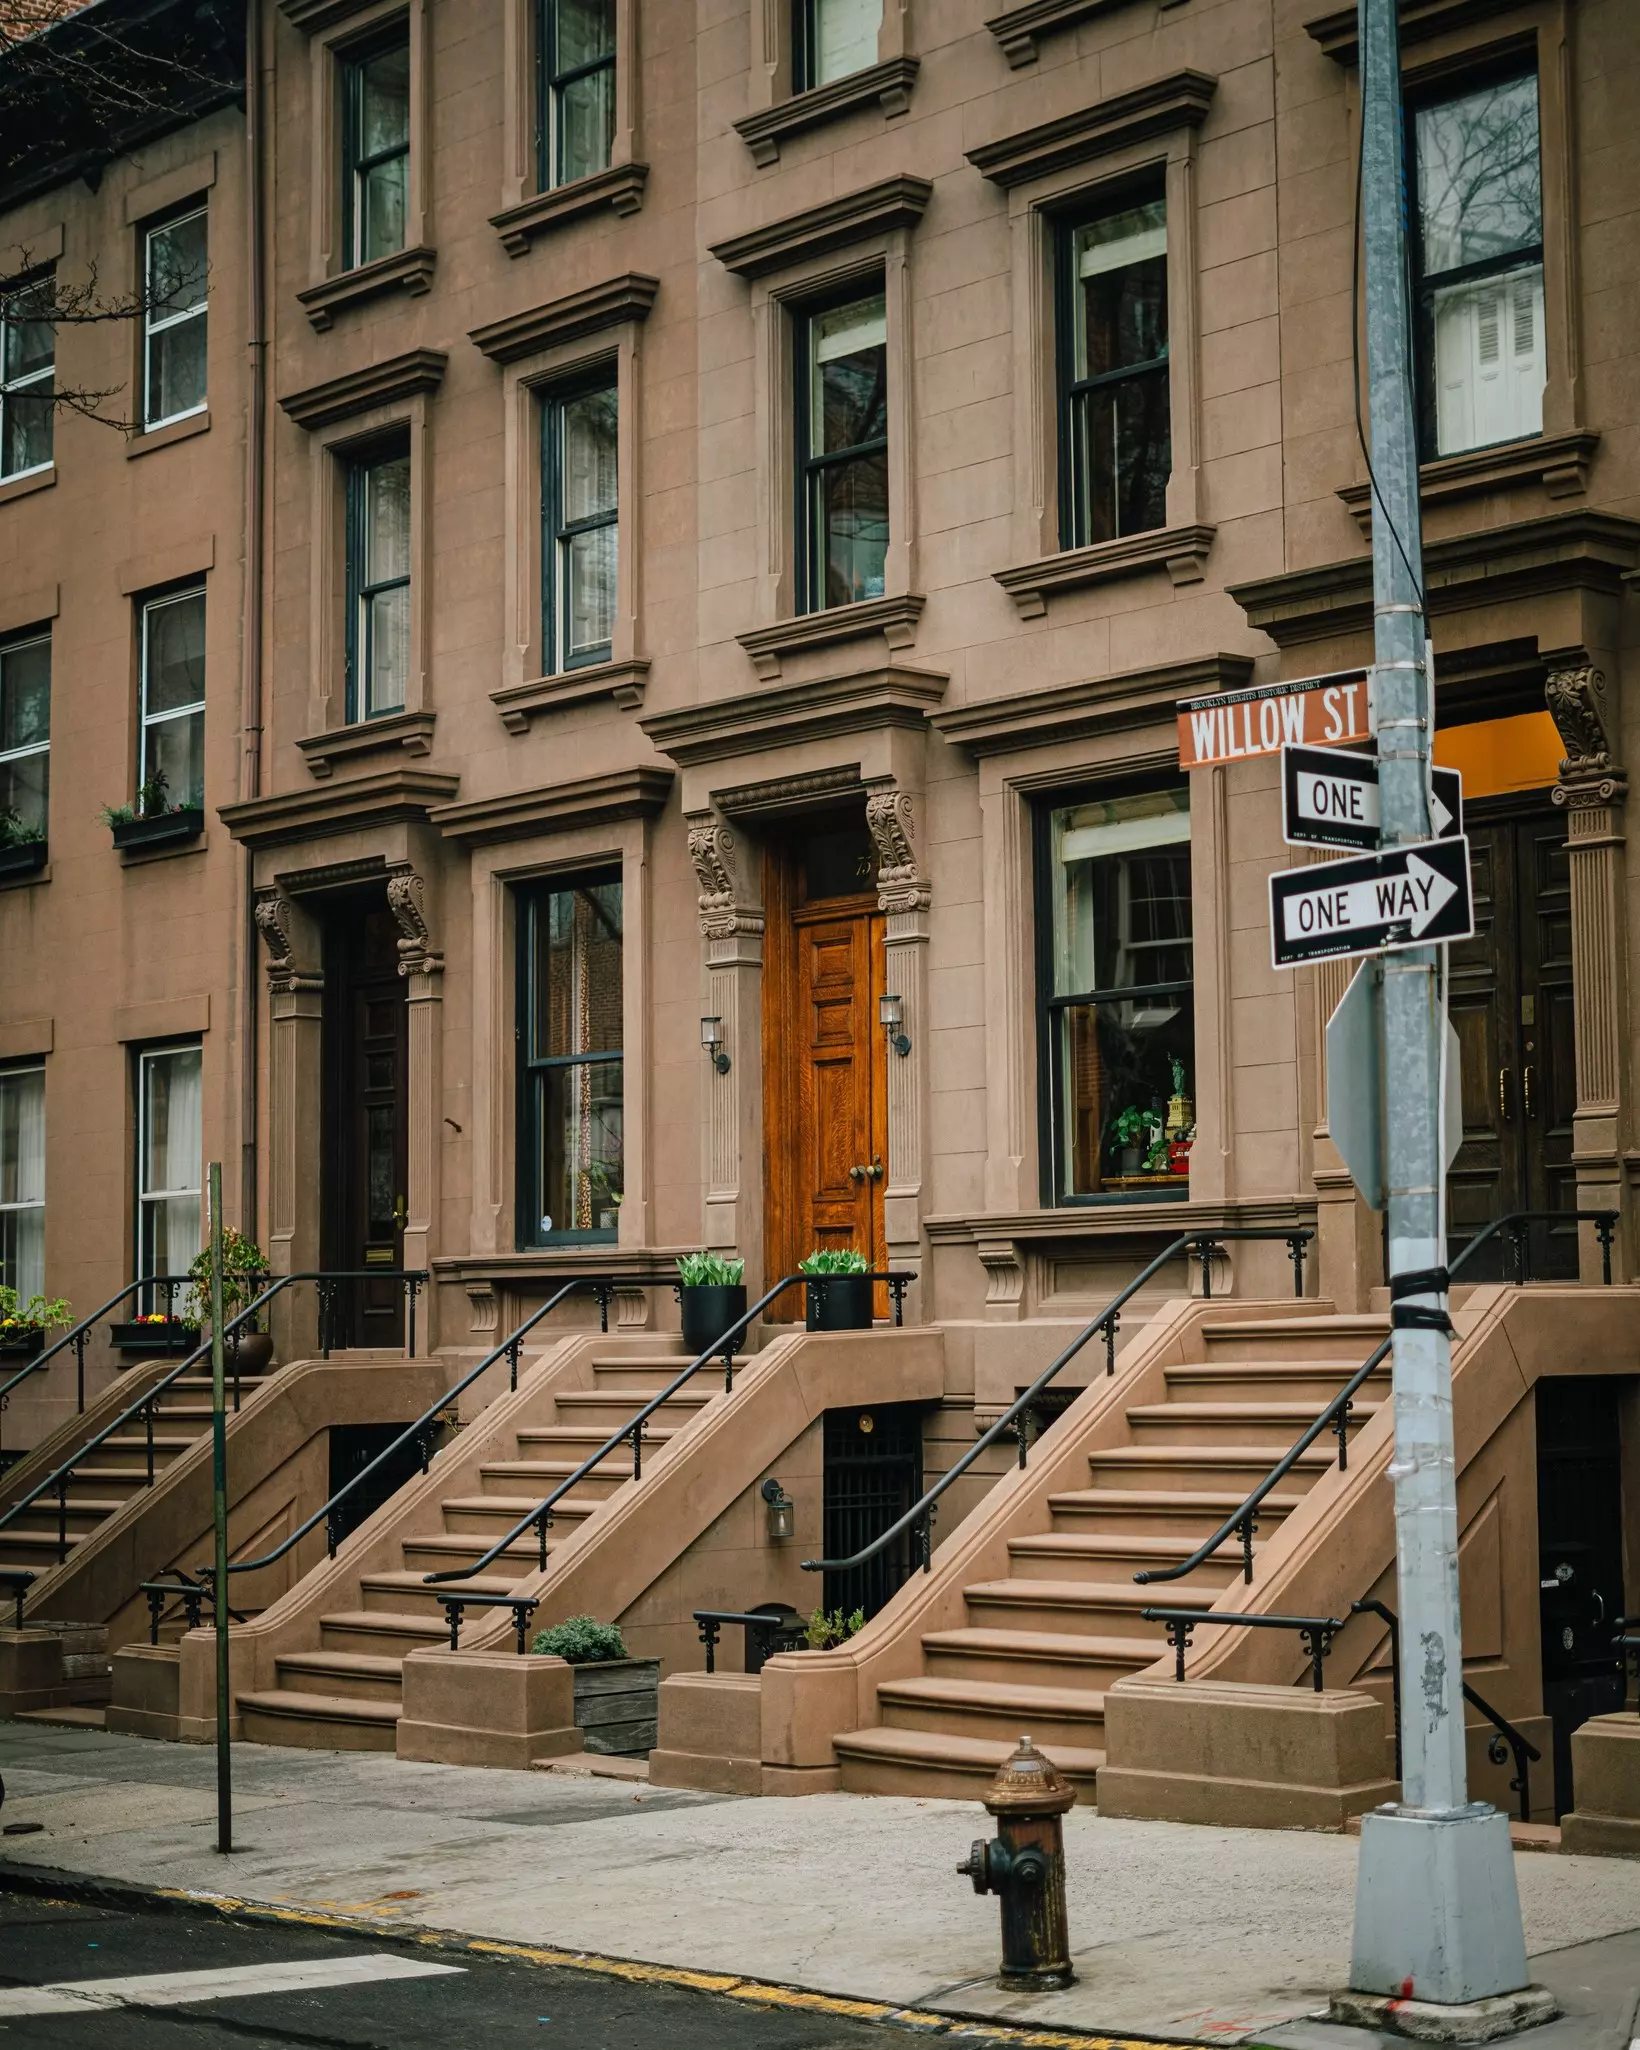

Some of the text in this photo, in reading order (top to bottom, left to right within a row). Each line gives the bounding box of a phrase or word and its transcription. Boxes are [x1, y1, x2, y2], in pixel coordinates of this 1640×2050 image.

[1190, 679, 1321, 711] BROOKLYN HEIGHTS HISTORIC DISTRICT
[1190, 684, 1358, 763] WILLOW ST
[1312, 779, 1364, 821] ONE
[1321, 835, 1364, 846] TRANSPORTATION
[856, 855, 872, 876] 75
[1298, 874, 1435, 933] ONE WAY
[1308, 944, 1351, 957] TRANSPORTATION
